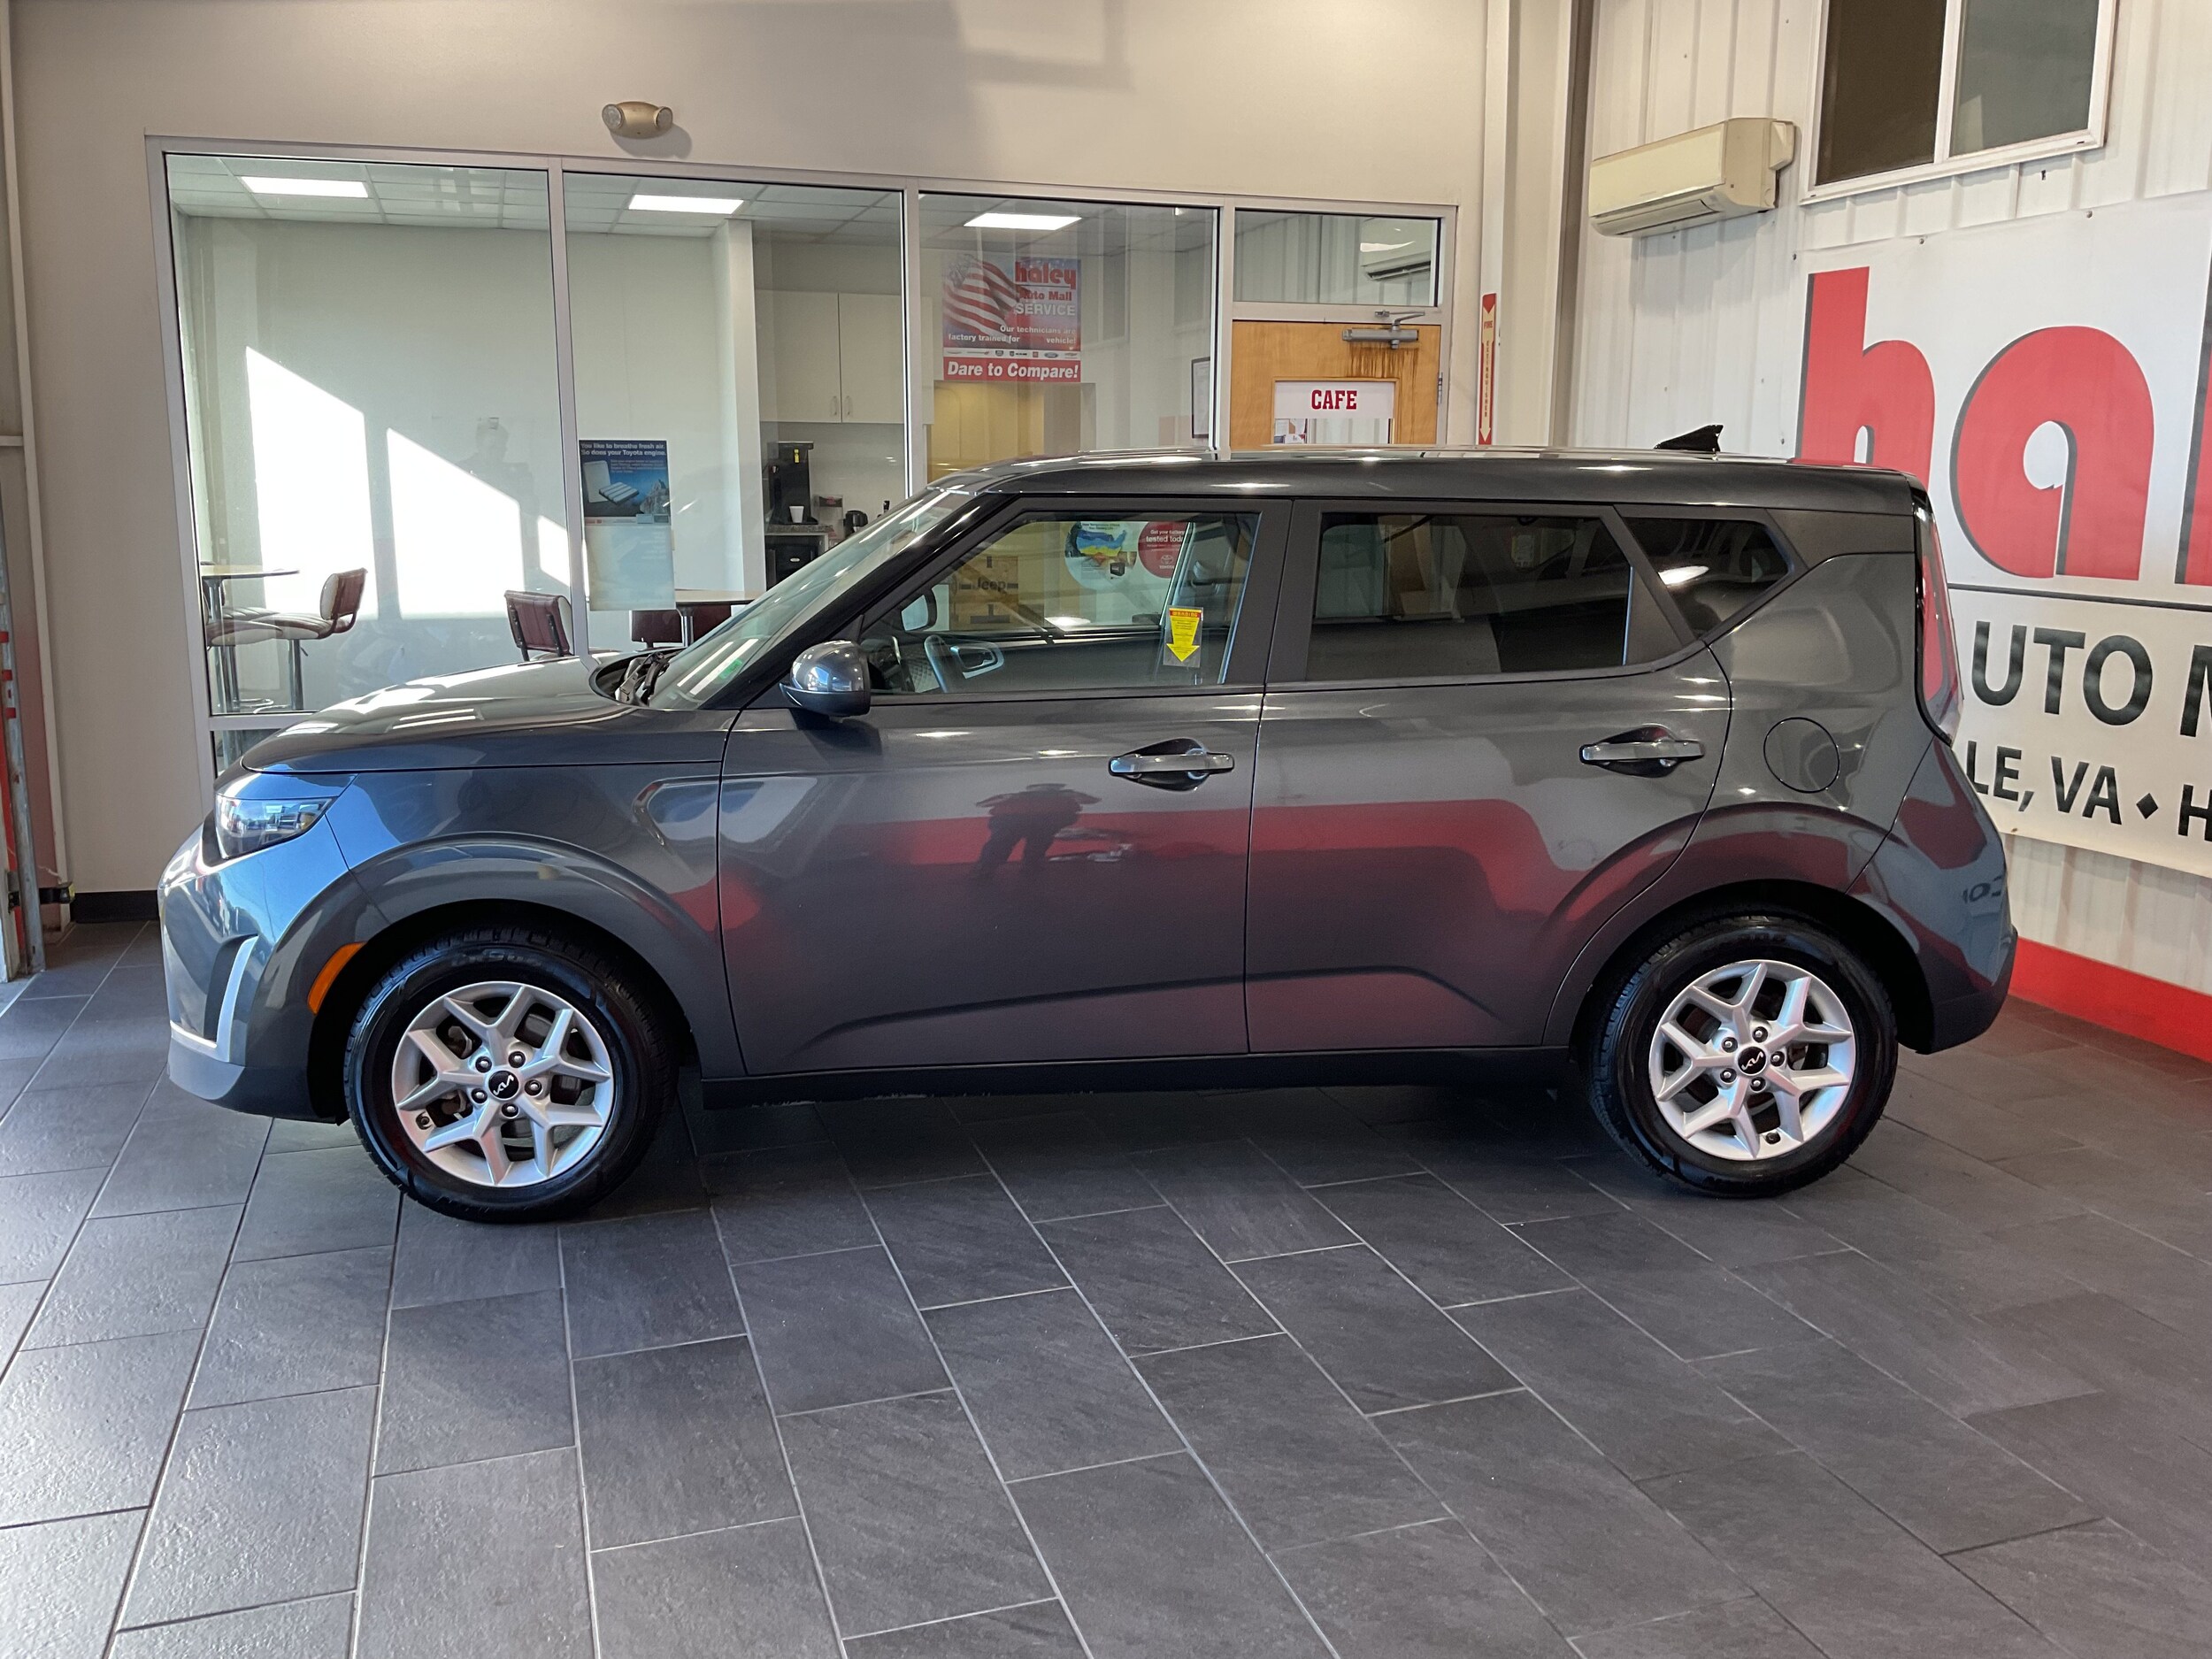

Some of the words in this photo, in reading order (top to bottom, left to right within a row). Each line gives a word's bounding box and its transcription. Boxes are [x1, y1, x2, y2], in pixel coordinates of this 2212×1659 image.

[1014, 261, 1077, 290] haley
[1048, 291, 1072, 302] Mall
[1013, 303, 1076, 316] SERVICE
[1017, 326, 1062, 334] technicians
[1483, 320, 1494, 330] FIRE
[948, 333, 977, 342] factory
[1009, 334, 1020, 343] for
[947, 361, 984, 376] Dare
[987, 363, 1003, 377] to
[1007, 362, 1079, 380] Compare!
[1311, 389, 1357, 410] CAFE
[976, 577, 1007, 594] Jeep
[1971, 620, 2154, 726] UTO
[1965, 740, 2034, 812] LE,
[2051, 756, 2122, 825] VA
